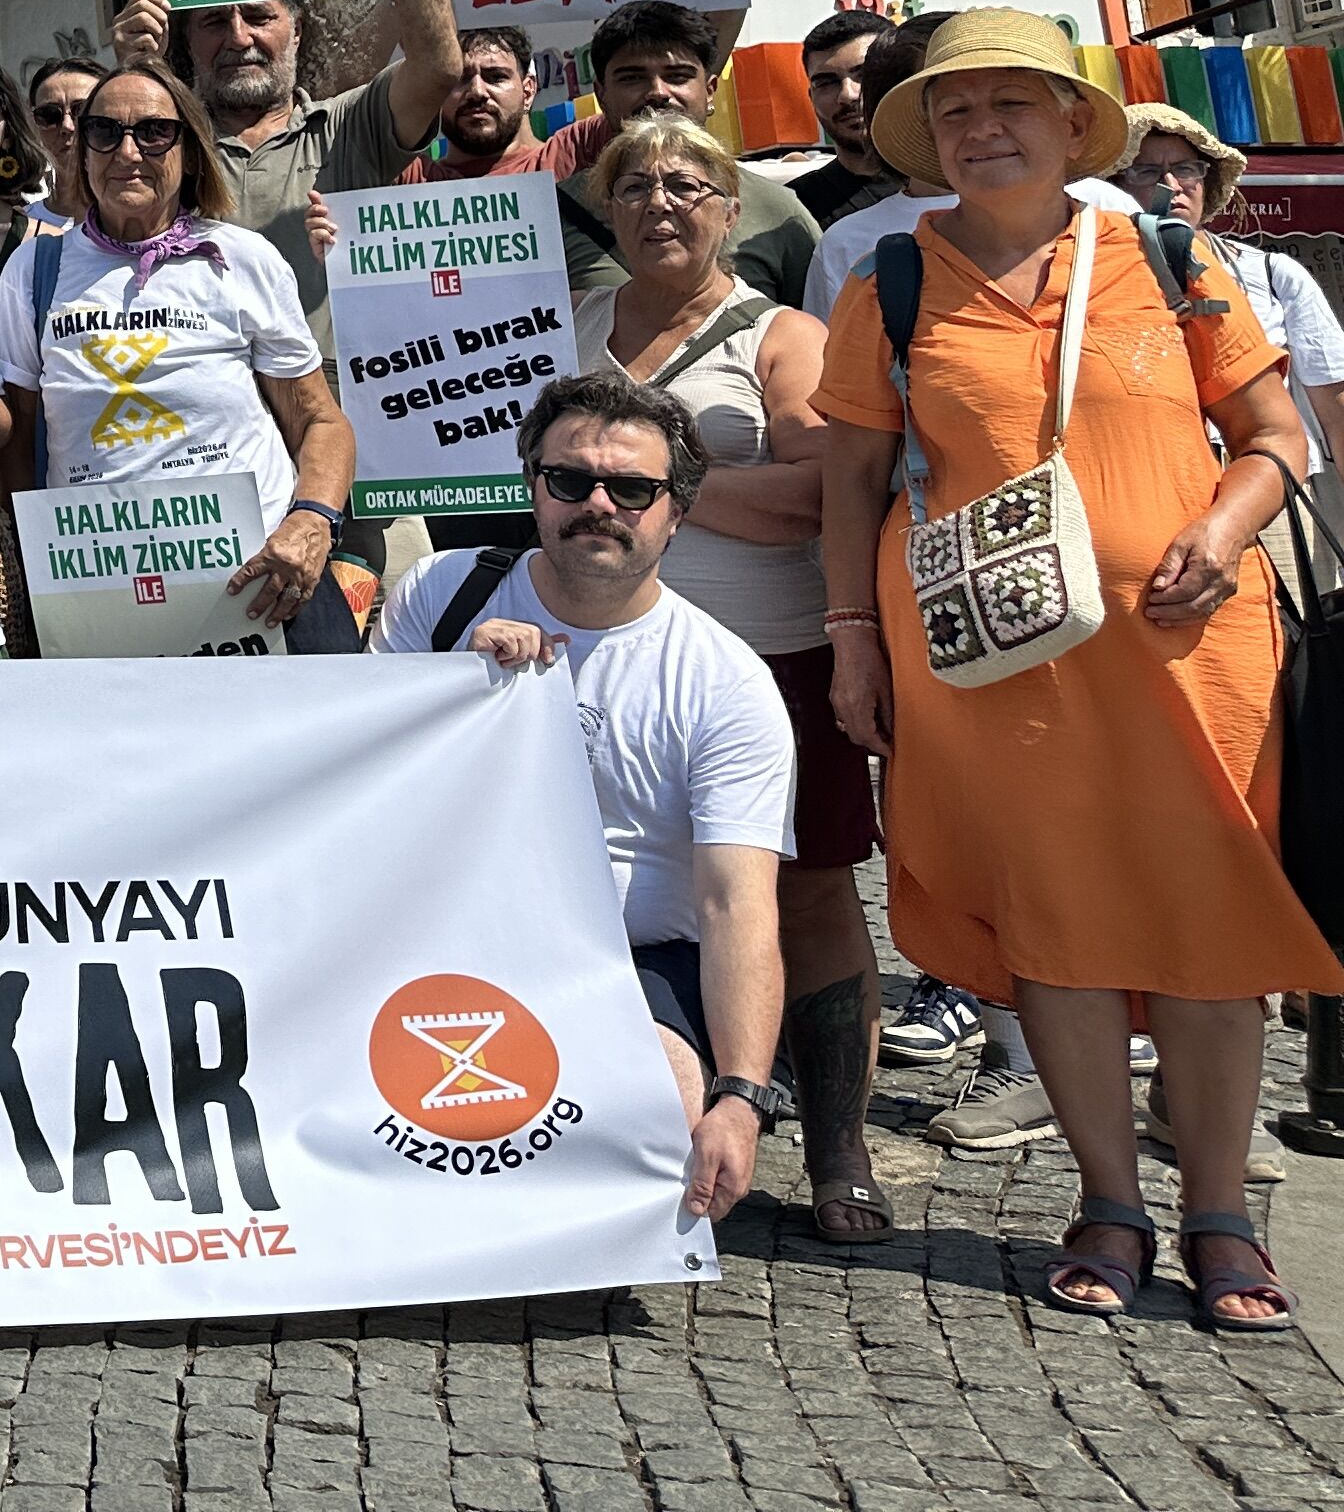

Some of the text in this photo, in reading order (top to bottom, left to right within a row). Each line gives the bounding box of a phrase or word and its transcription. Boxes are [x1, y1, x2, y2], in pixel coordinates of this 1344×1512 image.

[358, 192, 520, 234] HALKLARIN
[350, 225, 539, 275] İKLİM ZİRVESİ
[52, 308, 167, 340] HALKLARIN
[349, 306, 563, 384] fosili bırak
[380, 353, 556, 421] geleceğe
[433, 400, 525, 447] bak!
[55, 494, 222, 536] HALKLARIN
[48, 528, 243, 580] İKLİM ZİRVESİ
[373, 1097, 583, 1175] hiz2026.org
